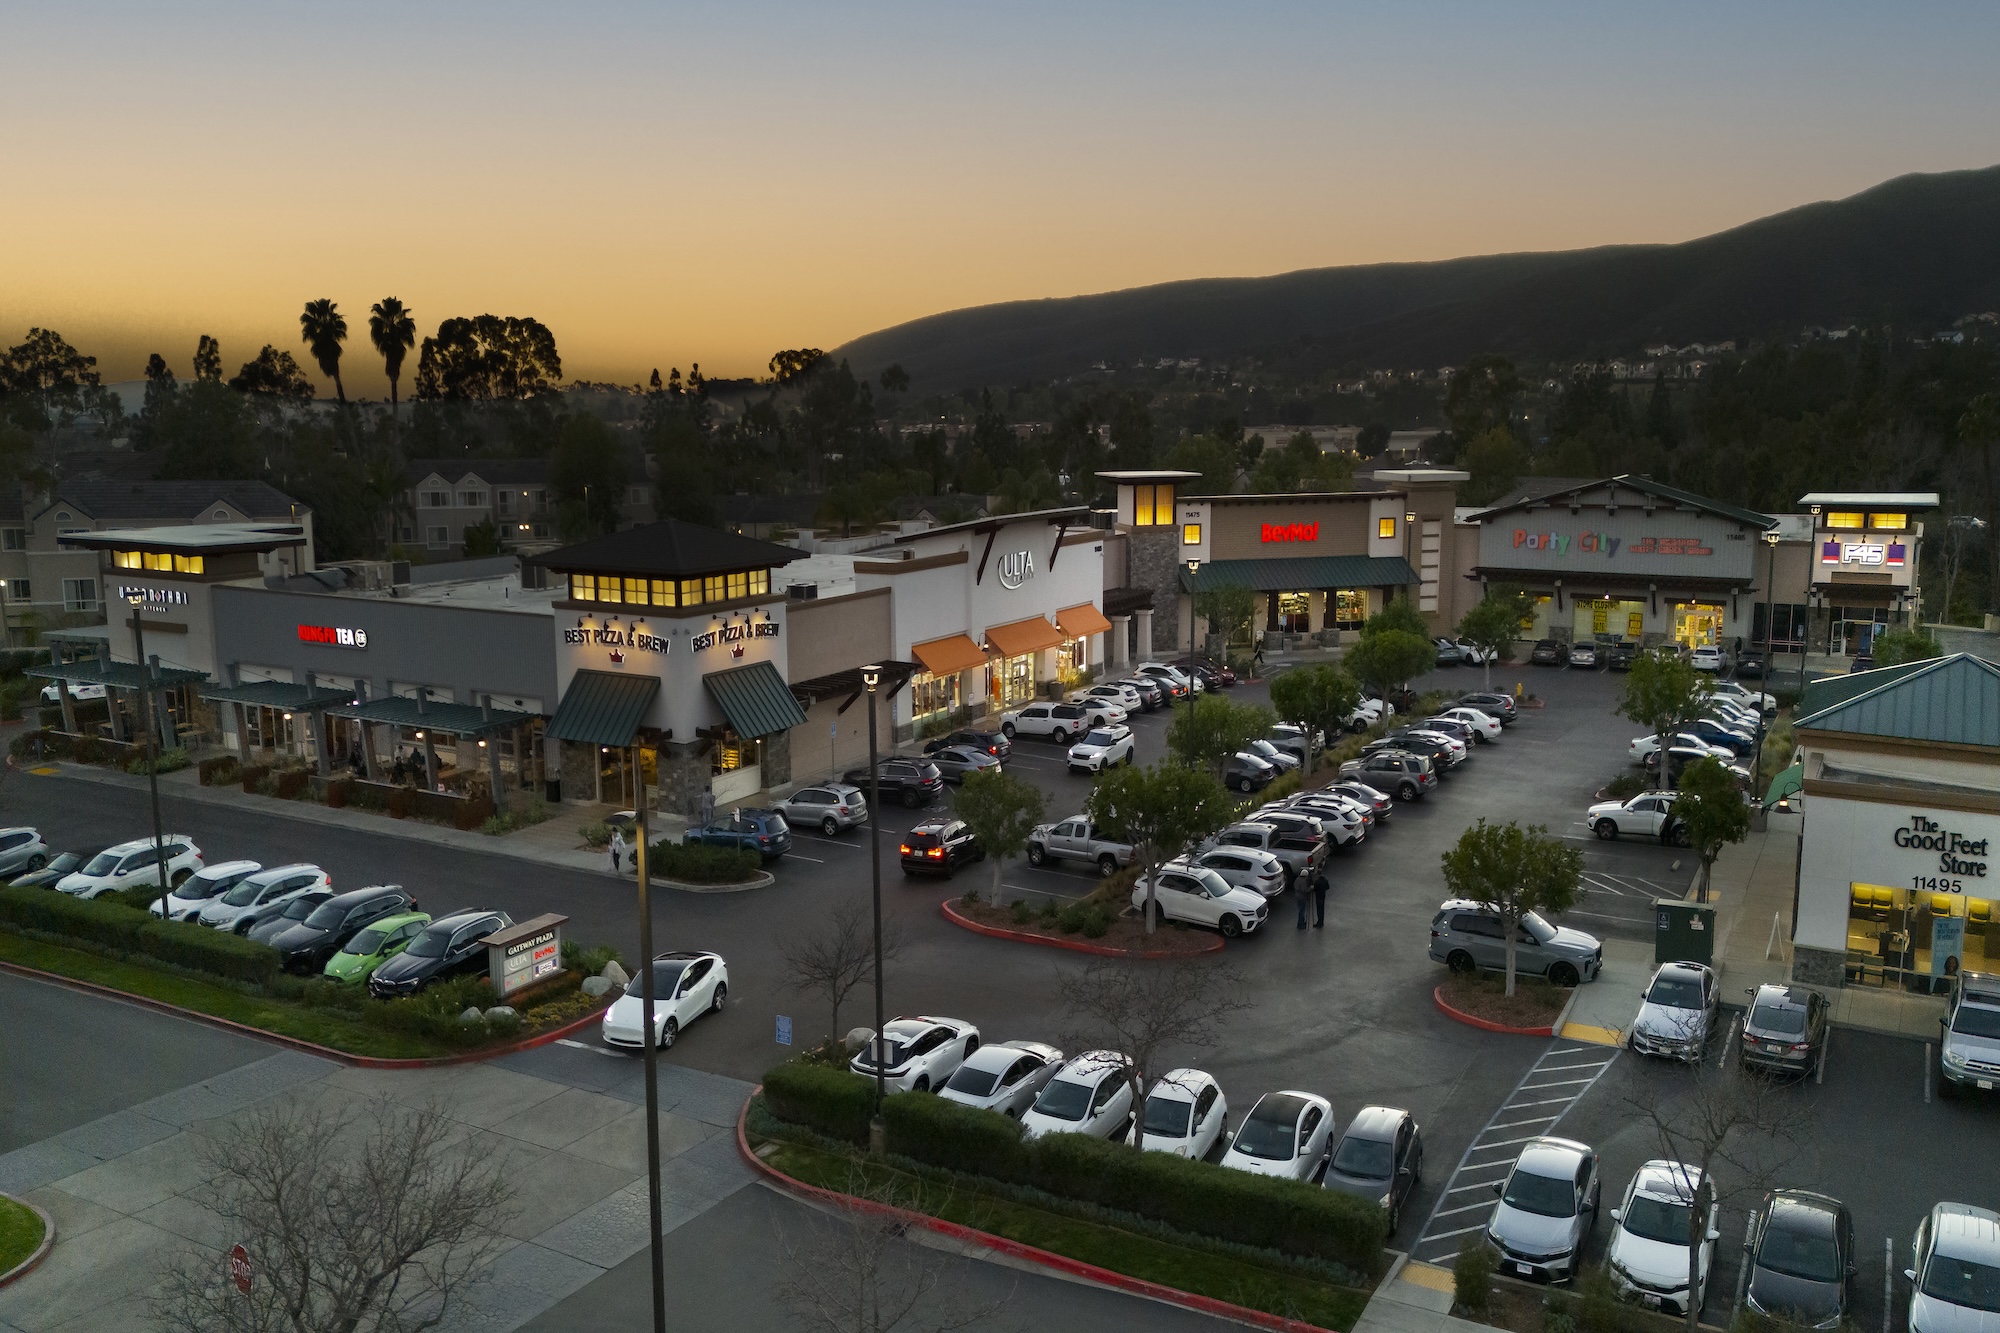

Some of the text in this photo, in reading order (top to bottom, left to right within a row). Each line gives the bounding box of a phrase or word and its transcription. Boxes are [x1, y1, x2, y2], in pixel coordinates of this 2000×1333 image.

[1261, 521, 1319, 543] BevMo!
[1513, 529, 1620, 558] Party City
[1842, 543, 1886, 565] F45
[1004, 550, 1034, 577] ULTA
[160, 590, 188, 605] THAI
[336, 627, 355, 646] TEA
[564, 628, 670, 654] BEST PIZZA & BREW
[691, 631, 716, 653] BEST
[718, 624, 745, 643] PIZZA
[754, 622, 780, 638] BREW
[1911, 815, 1938, 833] The
[1894, 827, 1989, 857] Good Feet
[1939, 852, 1988, 878] Store
[1912, 875, 1962, 894] 11495
[508, 932, 554, 955] GATEWAY PLAZA
[535, 944, 556, 959] BevMo!
[510, 955, 527, 967] ULTA
[232, 1257, 251, 1281] STOP
